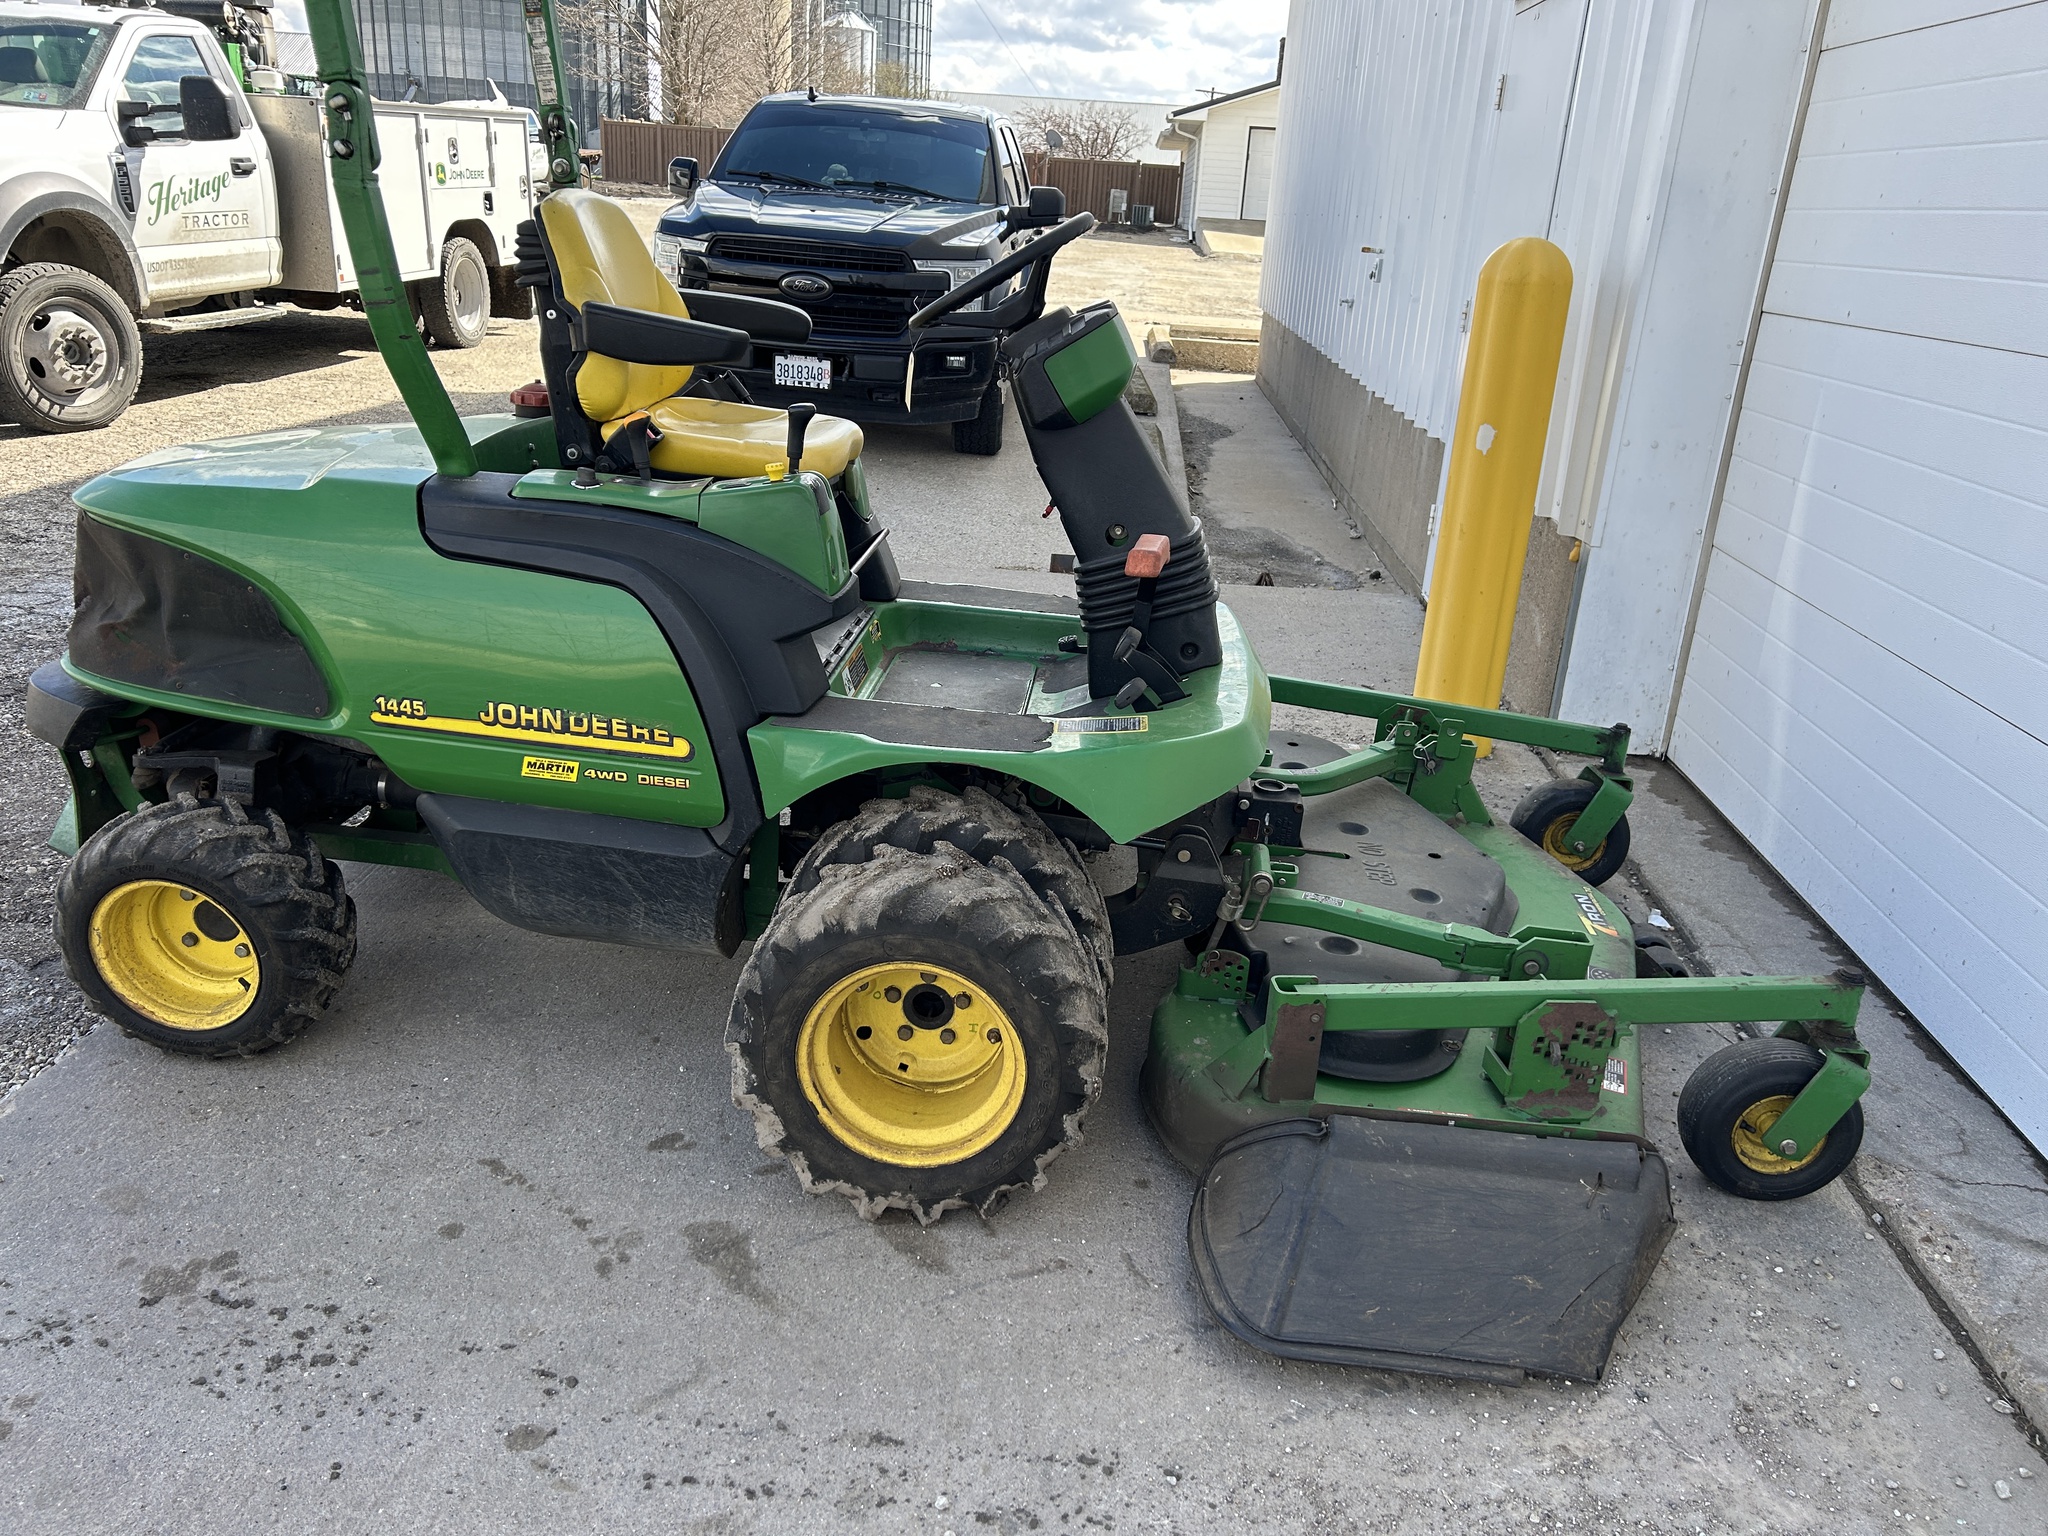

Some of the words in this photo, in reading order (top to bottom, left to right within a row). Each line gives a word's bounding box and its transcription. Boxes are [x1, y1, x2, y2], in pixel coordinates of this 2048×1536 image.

[449, 168, 465, 180] JOHN
[466, 168, 484, 179] DEERE
[147, 171, 230, 226] Heritage
[181, 212, 250, 229] TRACTOR
[147, 261, 169, 273] USDOT
[793, 279, 818, 292] Ford
[375, 695, 426, 717] 1445
[480, 702, 562, 731] JOHN
[527, 760, 575, 774] MARTIN
[584, 768, 628, 782] 4WD
[1362, 860, 1398, 886] STEP
